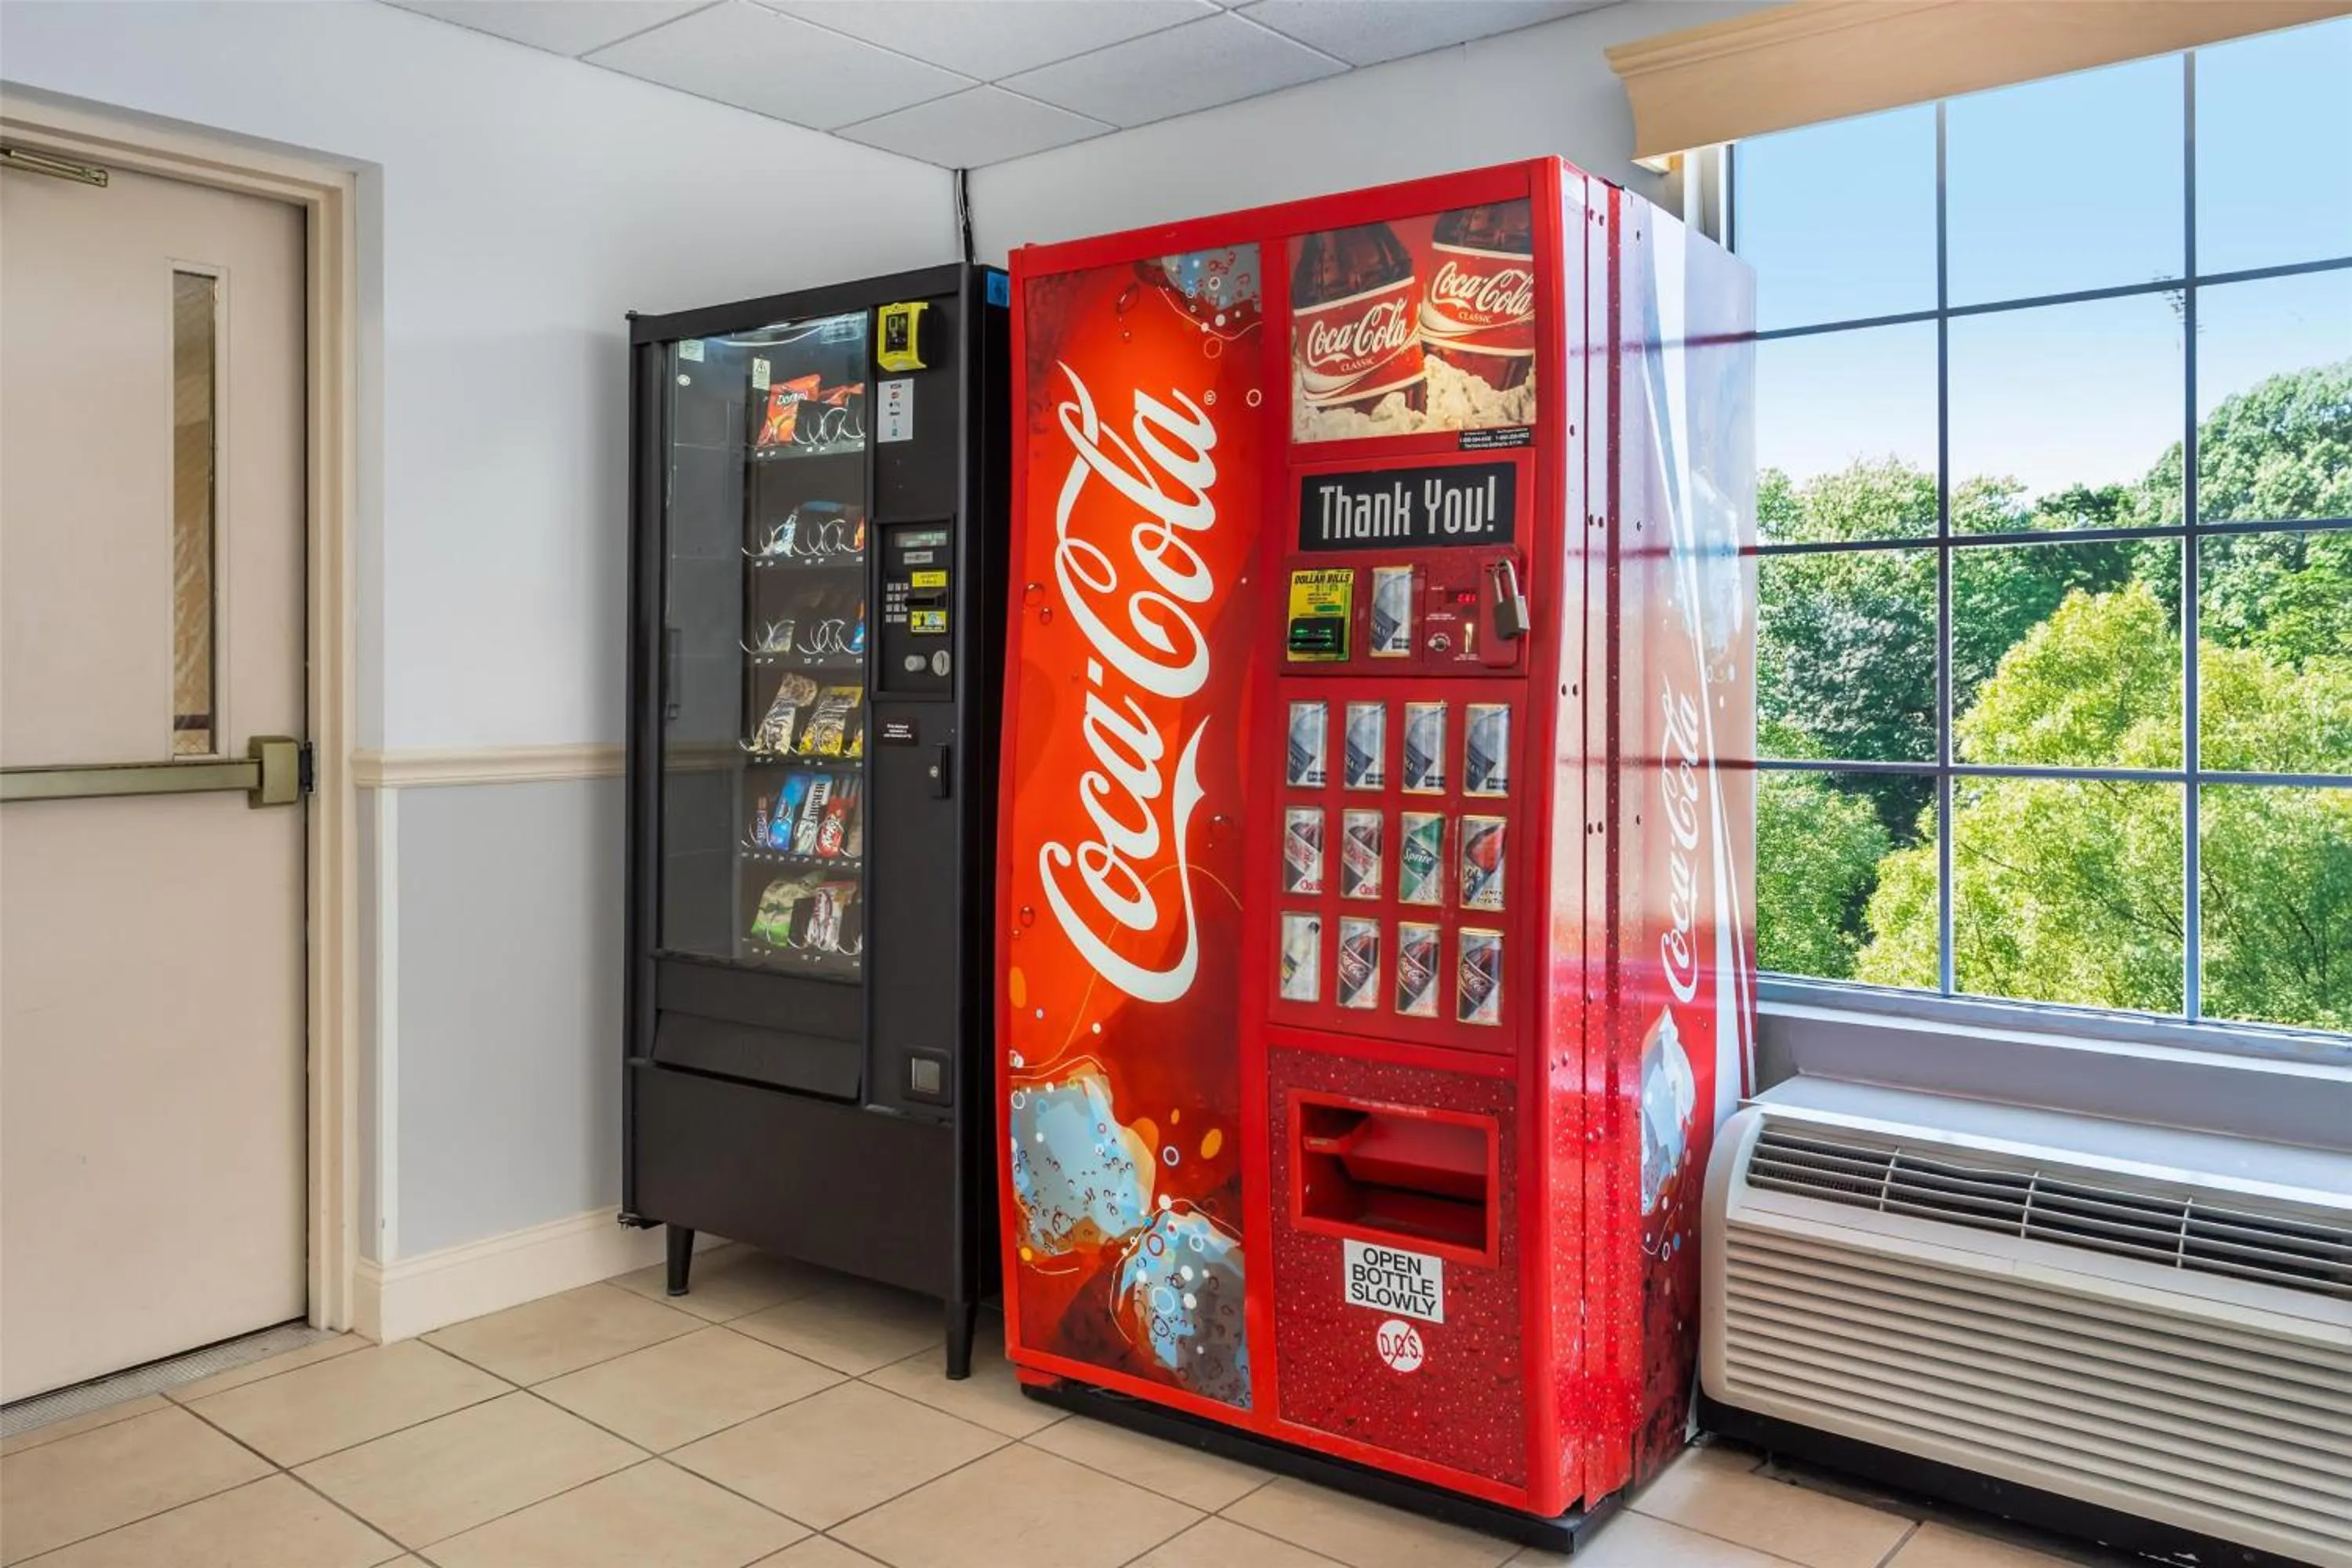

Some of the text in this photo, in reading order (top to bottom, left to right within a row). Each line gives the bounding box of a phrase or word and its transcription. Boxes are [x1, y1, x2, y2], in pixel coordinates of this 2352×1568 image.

[1431, 261, 1534, 314] Coca-Cola
[1307, 298, 1409, 367] Coca-Cola
[1458, 311, 1493, 324] CLASSIC
[1341, 357, 1375, 372] CLASSIC
[1319, 475, 1496, 539] Thank You!
[1039, 360, 1218, 1003] Coca-Cola
[1661, 673, 1700, 1004] Coca-Cola
[1403, 848, 1433, 864] Sprite
[1363, 1247, 1421, 1276] OPEN
[1352, 1264, 1435, 1298] BOTTLE
[1351, 1282, 1436, 1316] SLOWLY
